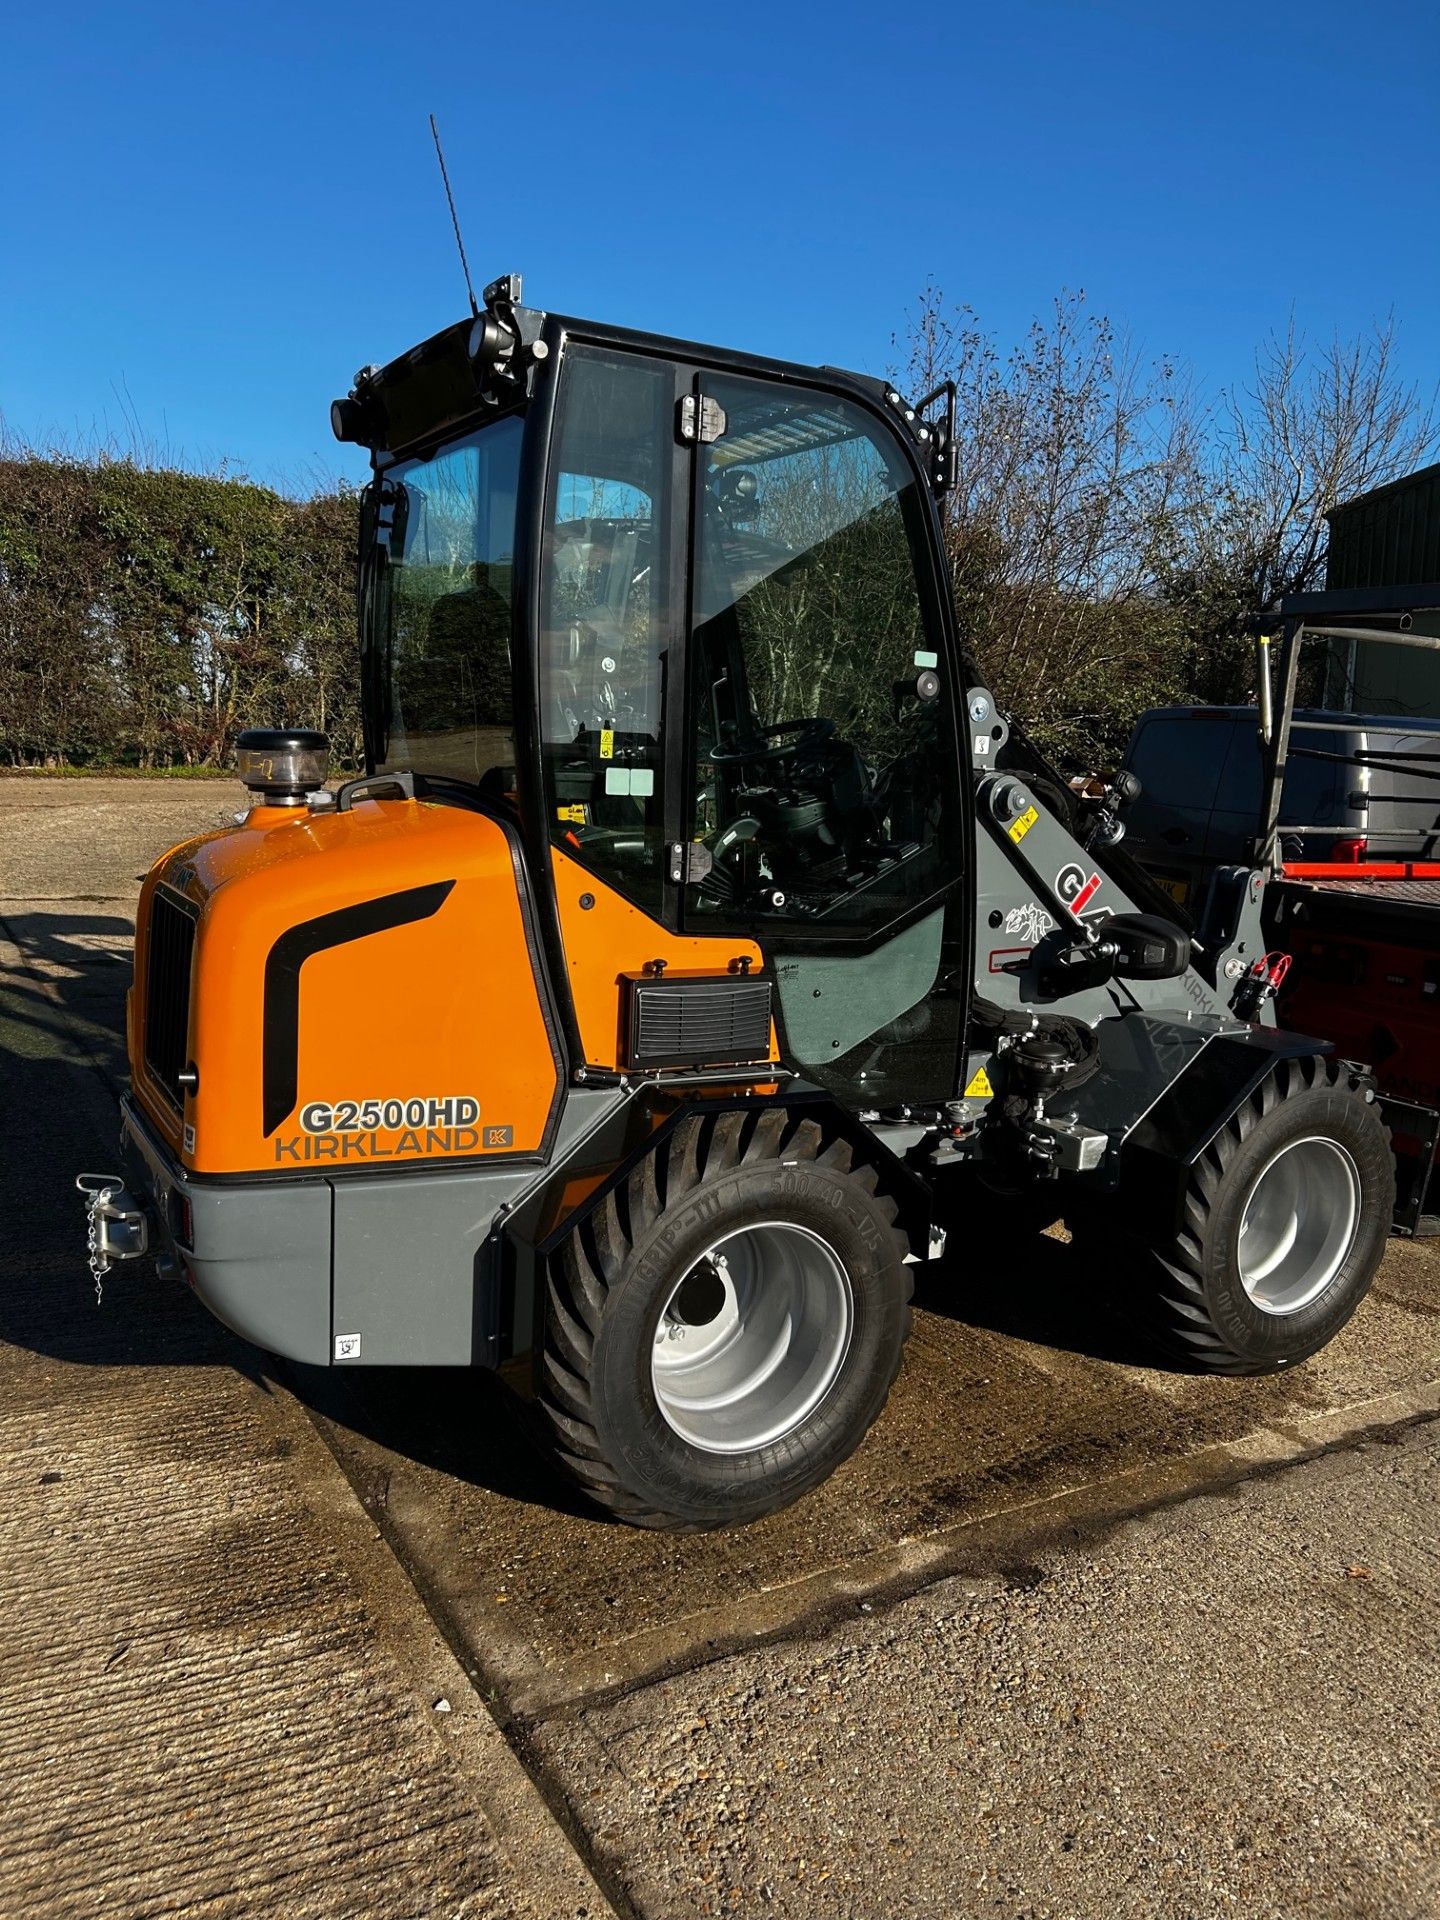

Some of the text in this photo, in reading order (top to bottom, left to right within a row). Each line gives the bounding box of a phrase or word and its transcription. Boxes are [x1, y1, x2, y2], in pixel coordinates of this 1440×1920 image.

[1055, 863, 1115, 942] GIA
[301, 1097, 479, 1133] G2500HD
[275, 1127, 479, 1161] KIRKLAND
